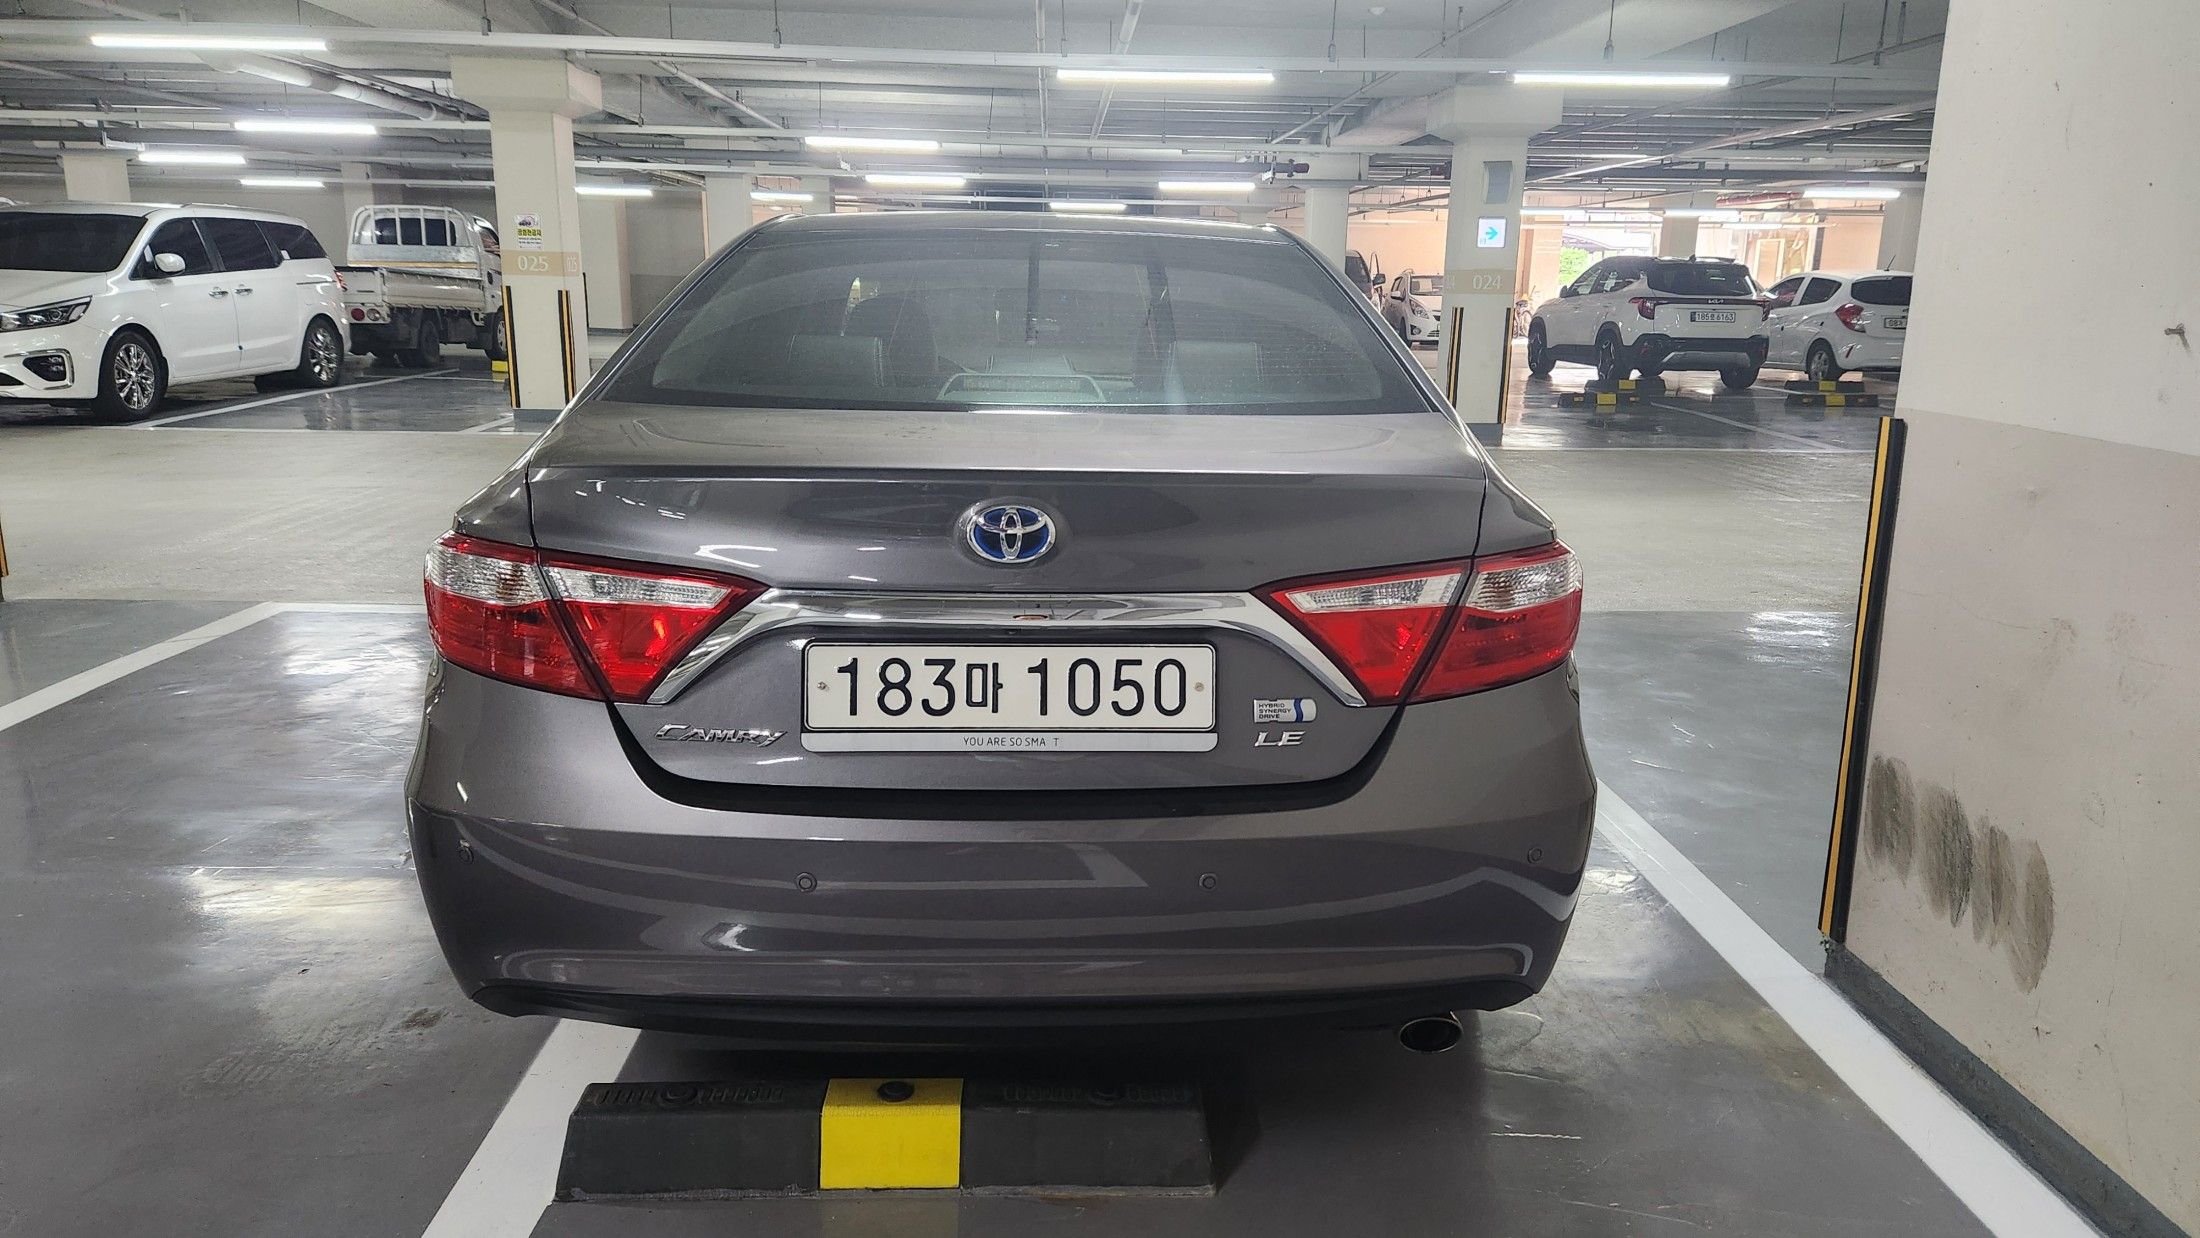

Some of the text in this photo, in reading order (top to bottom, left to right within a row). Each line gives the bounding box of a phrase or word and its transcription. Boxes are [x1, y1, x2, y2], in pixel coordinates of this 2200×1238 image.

[518, 255, 549, 272] 025
[1472, 275, 1502, 290] 024
[836, 657, 1187, 717] 183마 1050
[963, 737, 1060, 747] YOU ARE SO SMAT
[1254, 731, 1306, 747] LE
